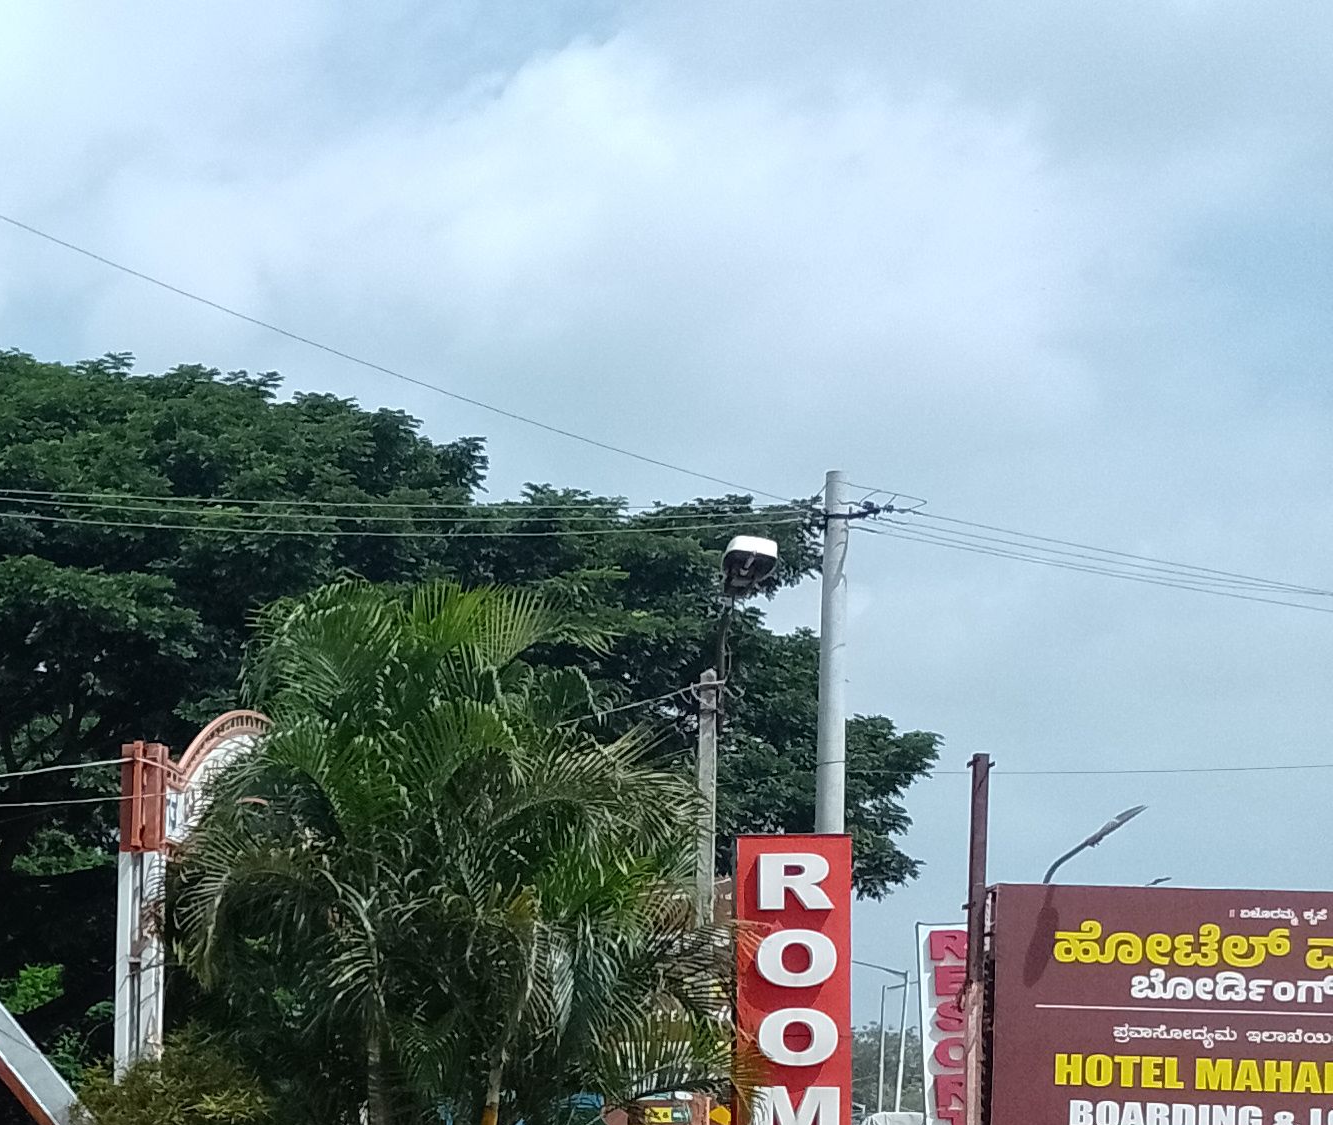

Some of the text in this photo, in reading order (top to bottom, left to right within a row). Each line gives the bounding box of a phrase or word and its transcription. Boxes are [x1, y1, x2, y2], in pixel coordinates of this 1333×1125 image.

[1052, 920, 1291, 968] ಹೋಟೆಲ್
[1112, 1022, 1333, 1049] ಪ್ರವಾಸೋದ್ಯಮ ಇಲಾಖೆಯಿ
[1053, 1053, 1185, 1091] HOTEL
